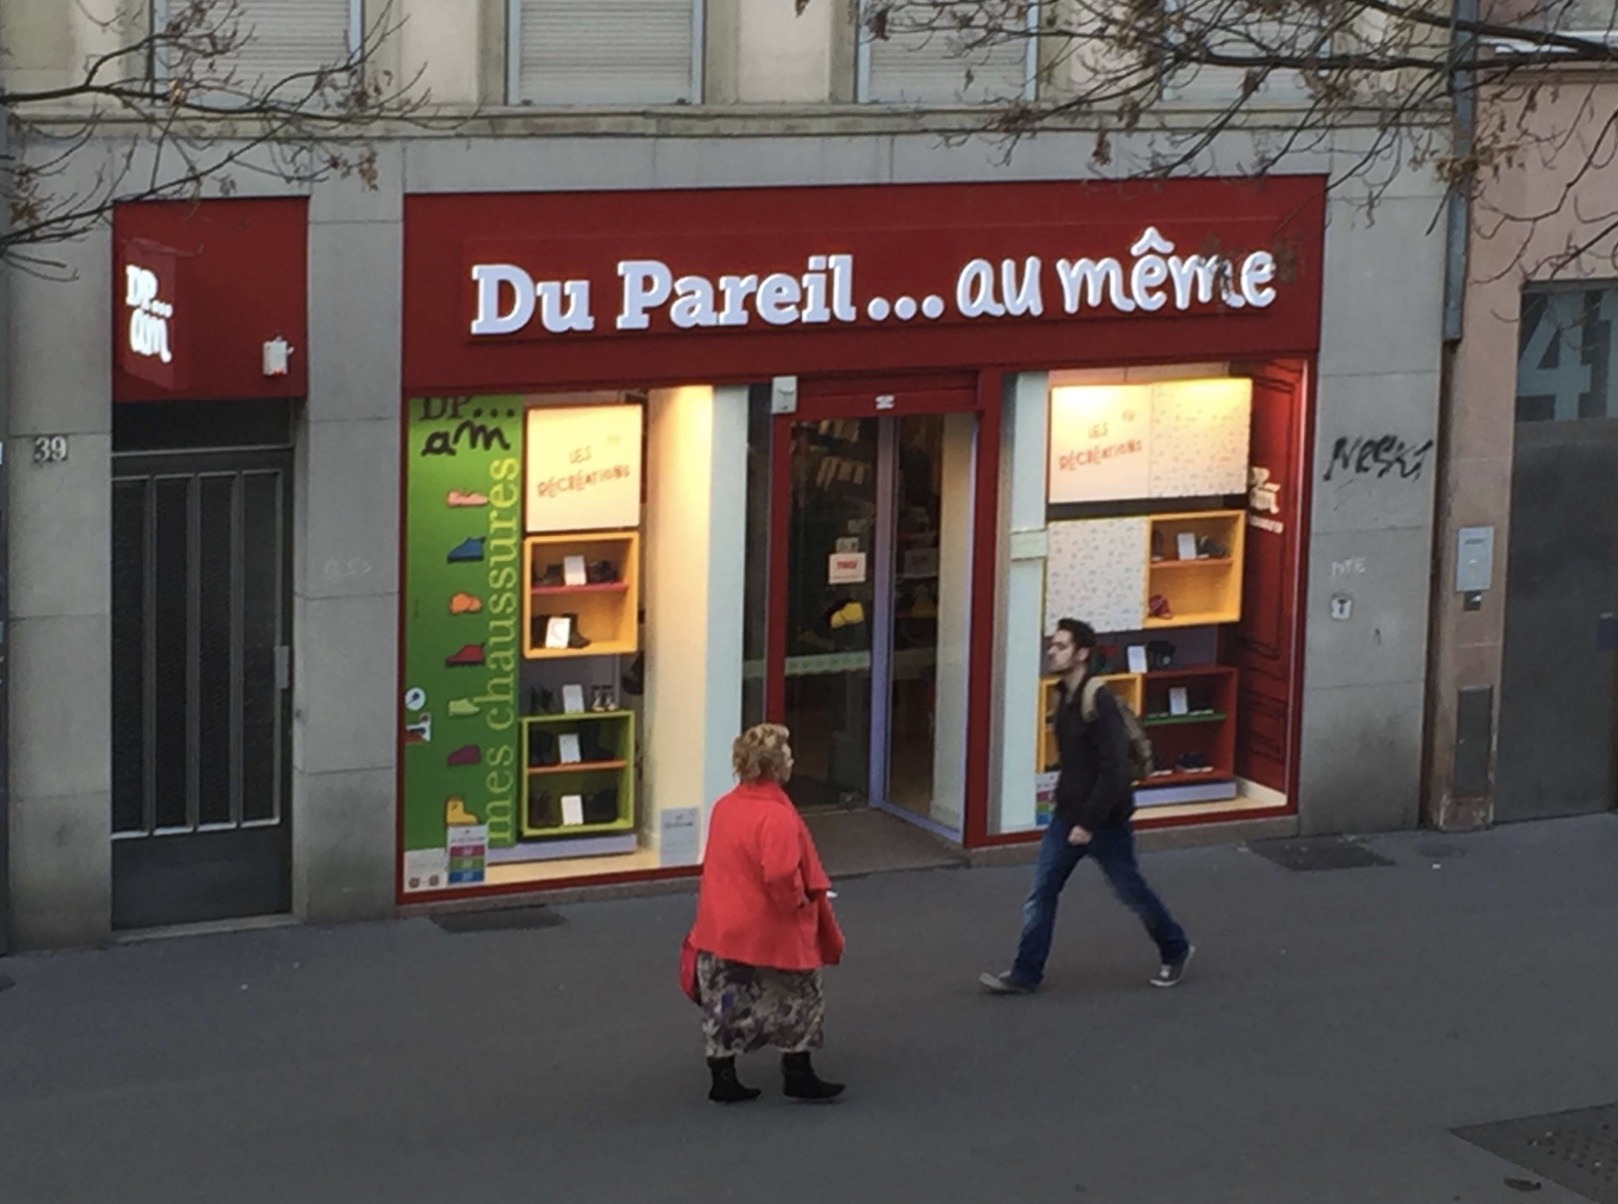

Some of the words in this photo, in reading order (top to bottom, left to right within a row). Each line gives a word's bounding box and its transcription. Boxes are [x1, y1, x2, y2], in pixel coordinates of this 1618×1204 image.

[471, 263, 595, 335] Du
[956, 256, 1044, 318] au
[1056, 226, 1277, 313] même
[34, 435, 67, 462] 39
[420, 420, 511, 457] am
[474, 456, 519, 731] chaussures
[484, 743, 516, 843] mes
